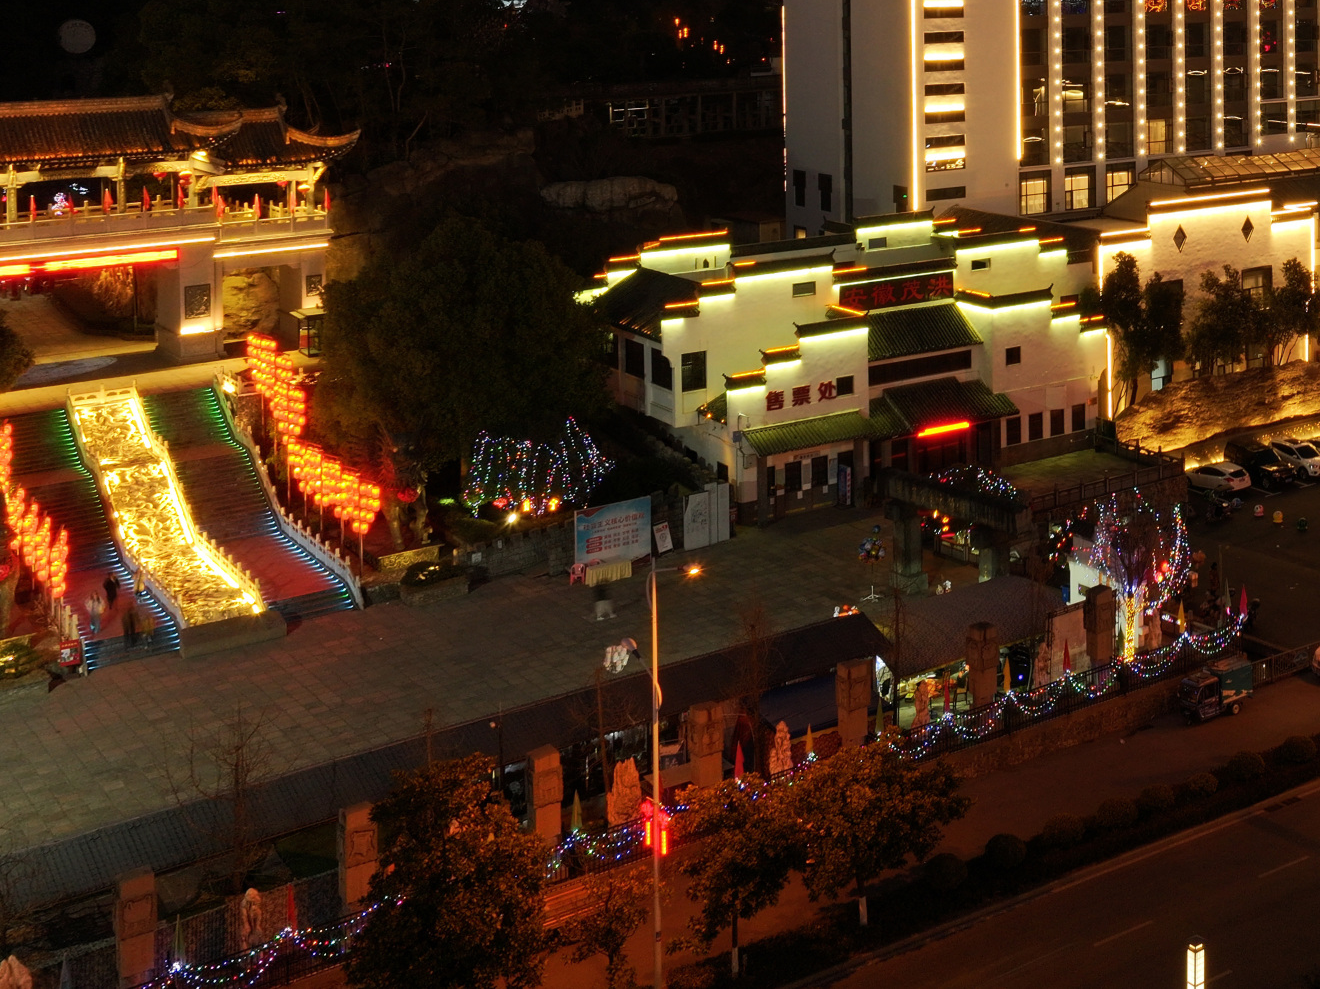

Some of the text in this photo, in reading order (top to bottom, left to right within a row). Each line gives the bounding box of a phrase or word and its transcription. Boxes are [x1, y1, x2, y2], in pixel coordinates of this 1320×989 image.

[842, 275, 952, 310] 安徽茂洪
[766, 381, 837, 411] 售票处
